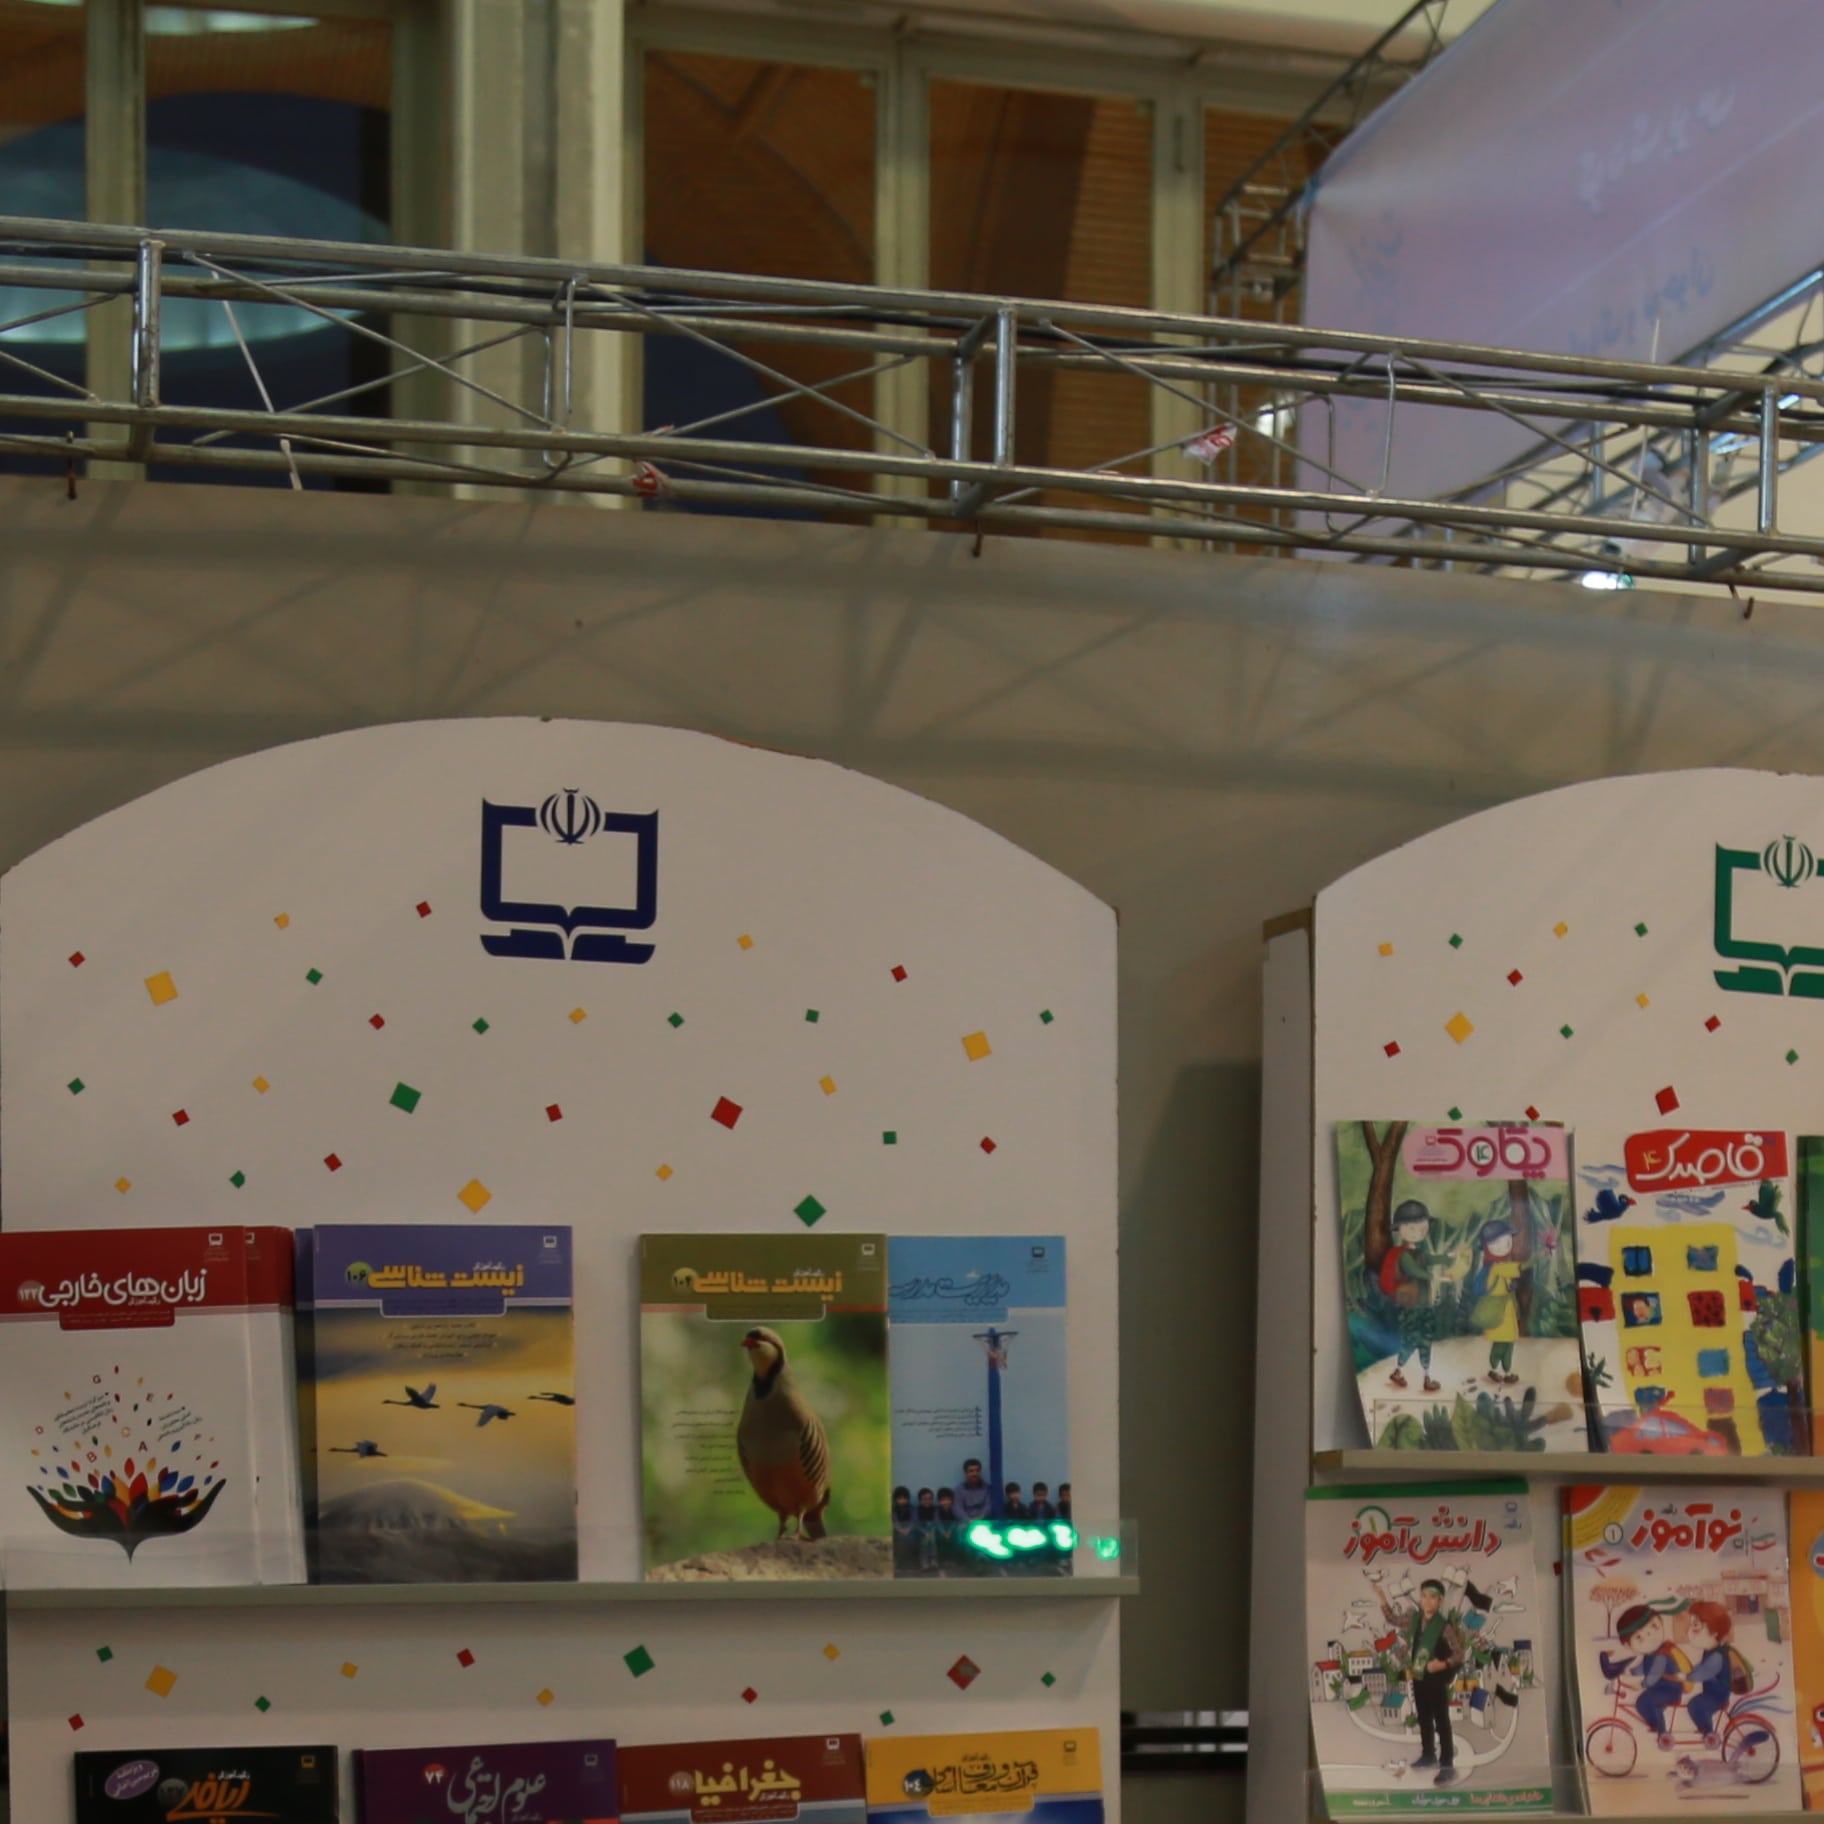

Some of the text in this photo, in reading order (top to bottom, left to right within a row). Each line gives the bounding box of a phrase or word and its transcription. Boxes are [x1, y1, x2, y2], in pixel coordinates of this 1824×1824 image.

[1636, 1133, 1764, 1184] قاصدک
[39, 1272, 104, 1308] خارجی
[161, 1268, 208, 1302] زبان
[450, 1264, 524, 1296] زیست
[771, 1270, 843, 1301] زیست
[1344, 1505, 1502, 1565] دانش آموز
[1630, 1503, 1742, 1554] نوآموز
[694, 1759, 802, 1807] جغرافیا
